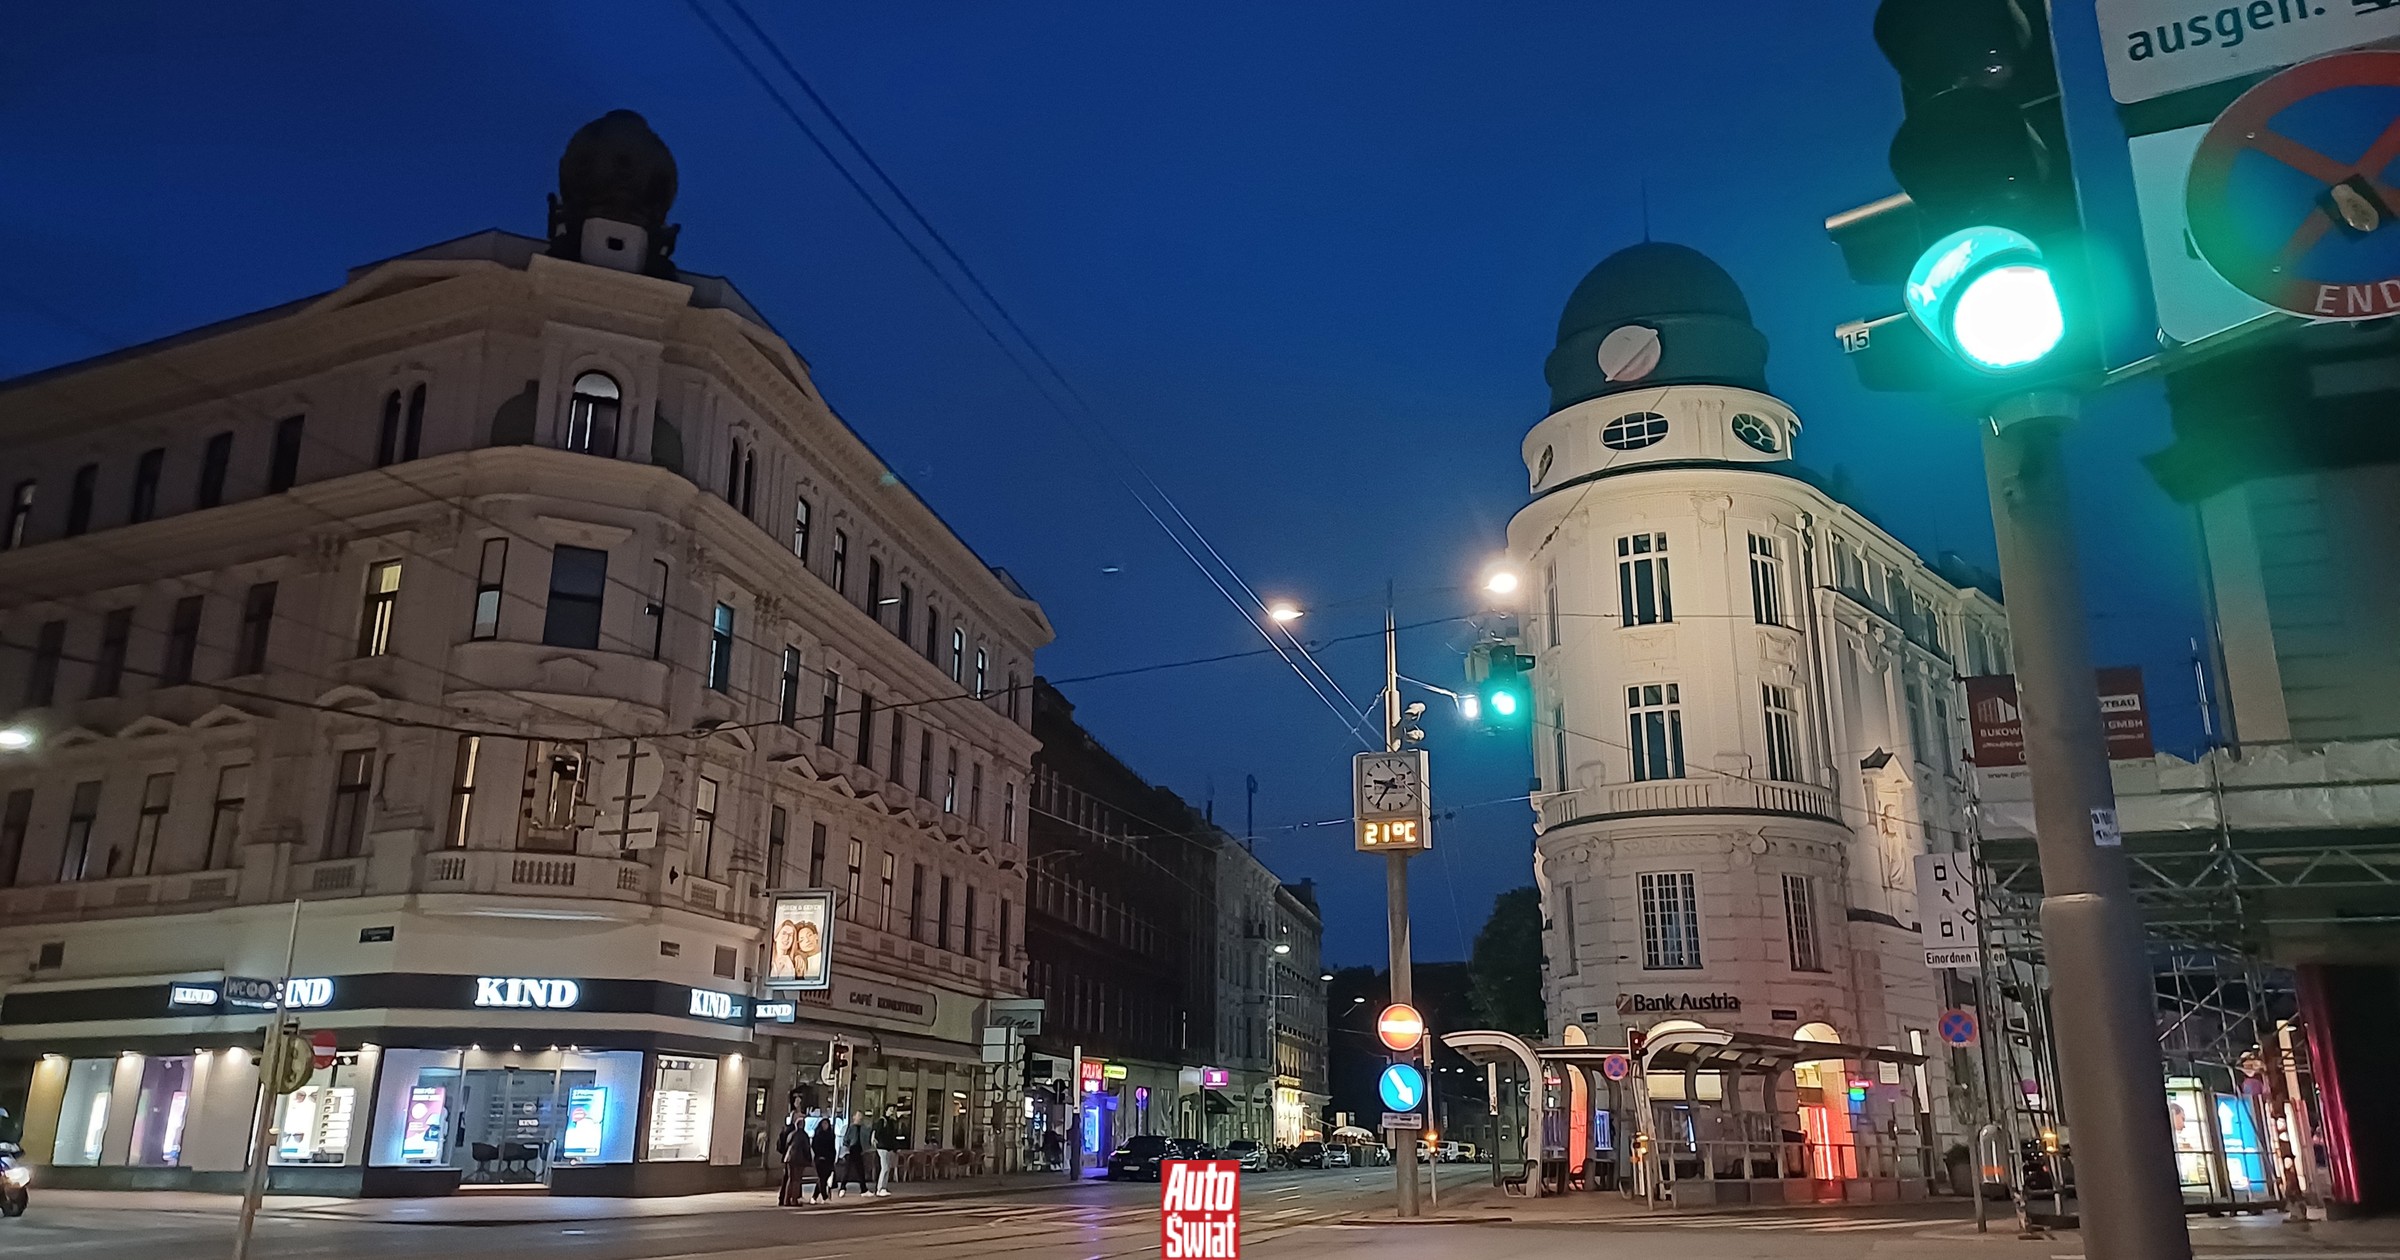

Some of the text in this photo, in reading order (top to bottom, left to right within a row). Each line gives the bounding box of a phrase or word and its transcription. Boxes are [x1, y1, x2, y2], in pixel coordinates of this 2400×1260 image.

[2127, 0, 2326, 62] ausgen.
[1844, 330, 1869, 351] 15
[2102, 698, 2136, 709] TBAU
[2107, 718, 2144, 730] GMBH
[1364, 821, 1416, 846] 21°C
[1926, 952, 1972, 964] Einordnen
[173, 987, 219, 1005] KIND
[228, 980, 247, 997] WC
[278, 977, 336, 1009] IND
[474, 977, 580, 1008] KIND
[689, 988, 733, 1020] KIND
[849, 991, 873, 1007] CAFÉ
[1633, 992, 1741, 1012] Bank Austria
[755, 1004, 793, 1019] KIND
